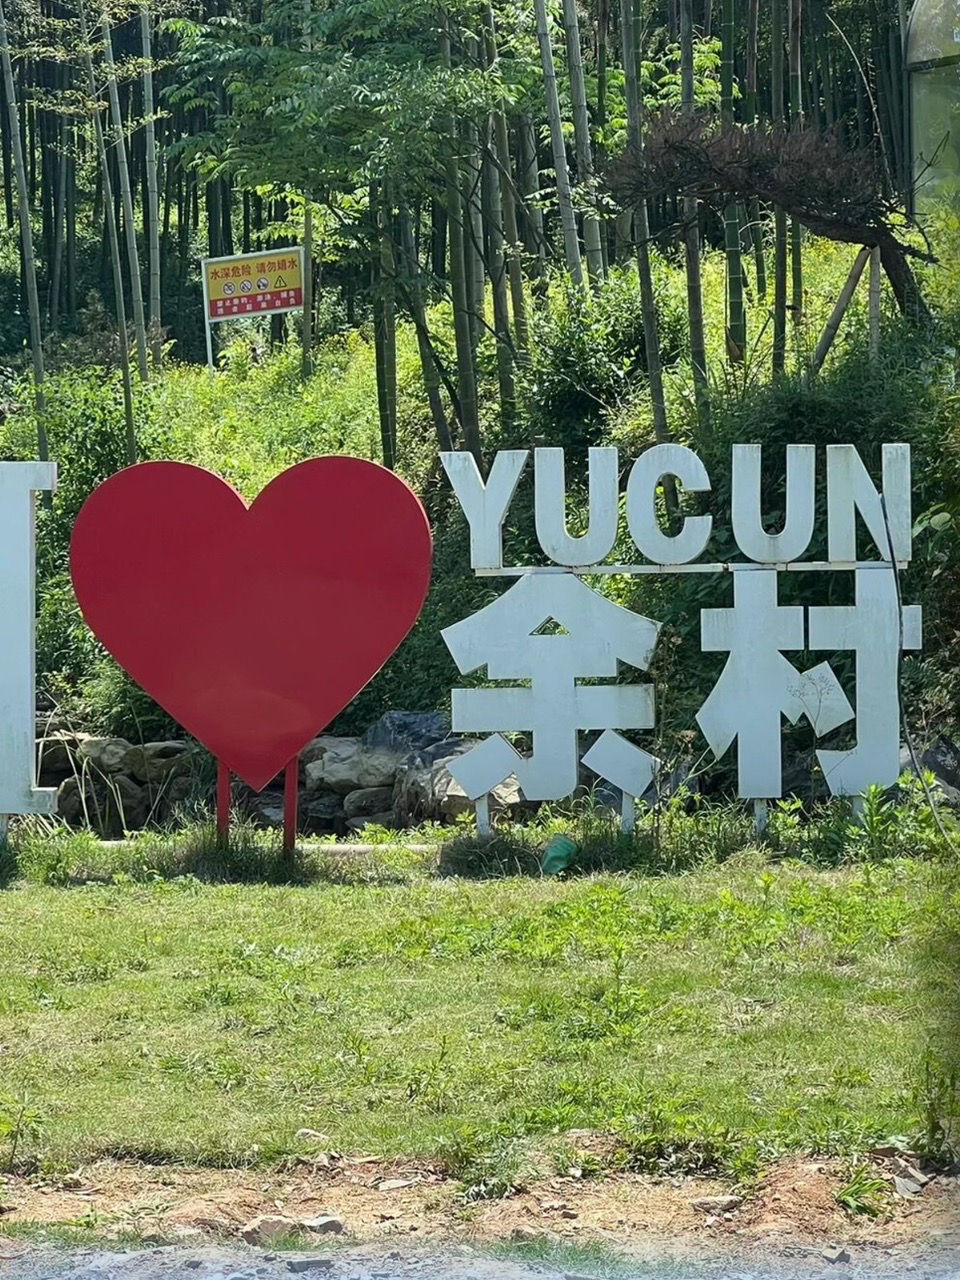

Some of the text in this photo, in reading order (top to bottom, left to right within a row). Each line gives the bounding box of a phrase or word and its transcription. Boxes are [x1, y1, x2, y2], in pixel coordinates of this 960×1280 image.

[210, 264, 251, 280] 水深危险
[438, 442, 912, 569] YUCUN
[441, 570, 923, 802] 余村
